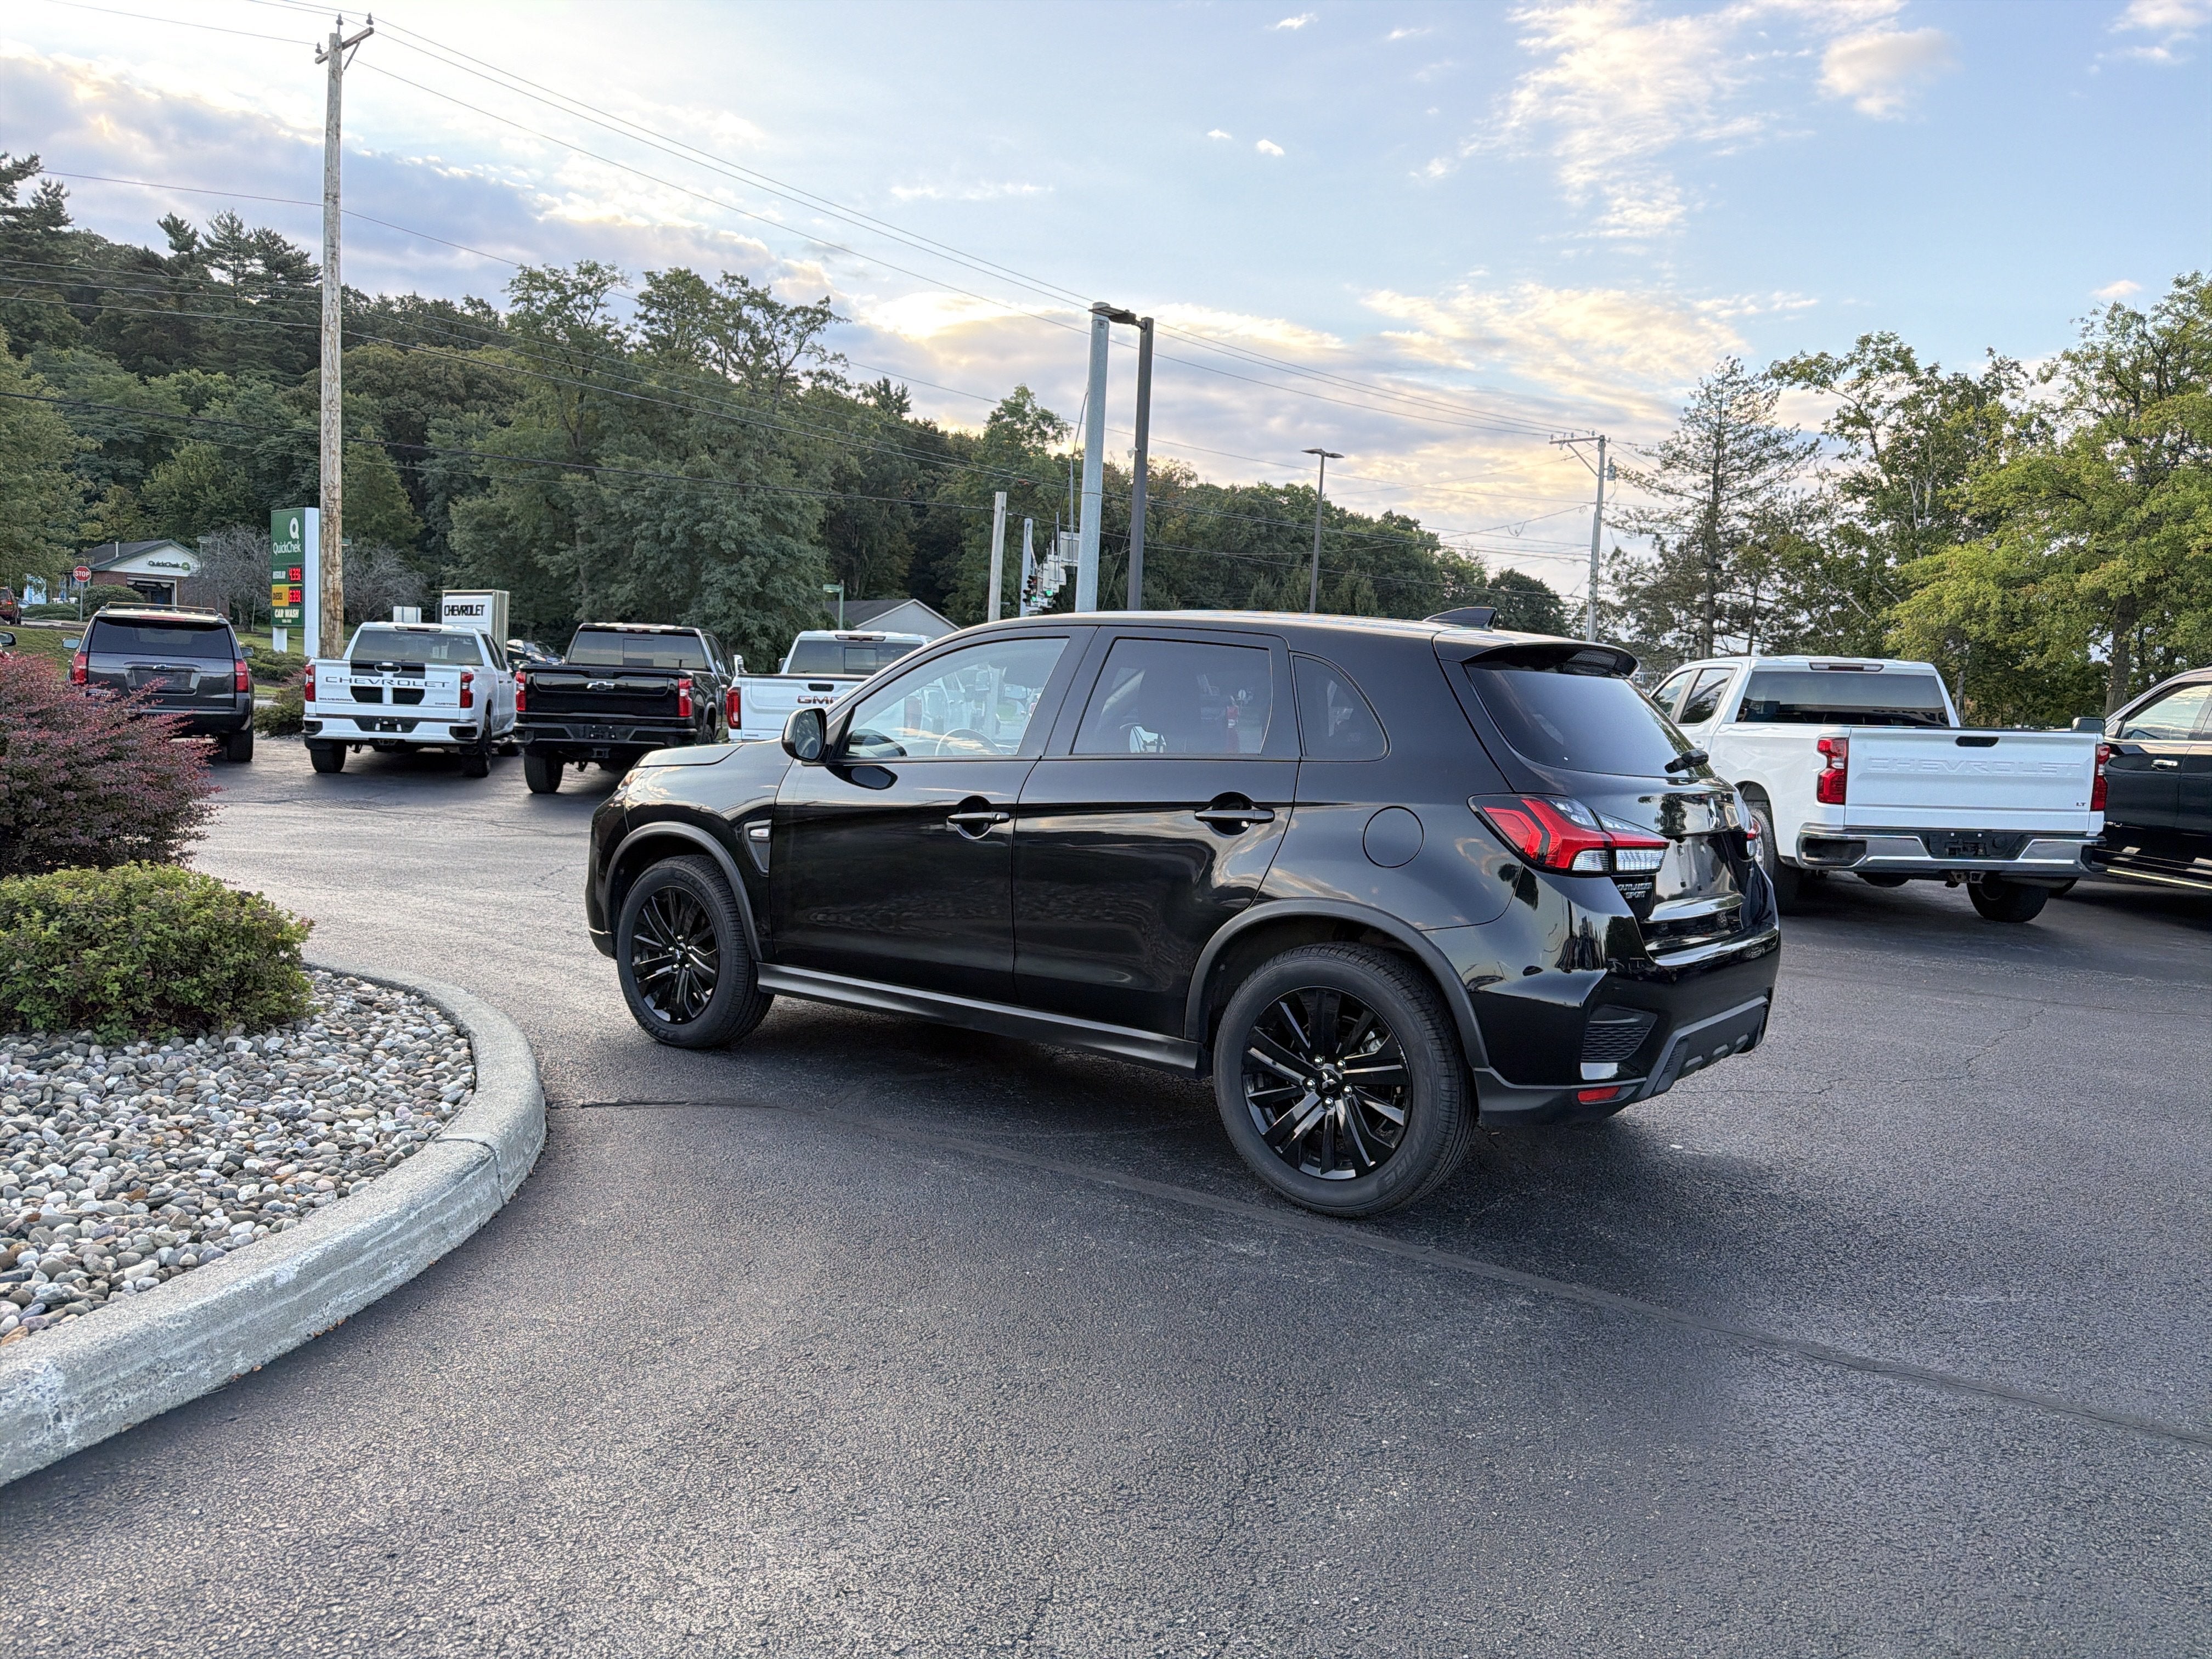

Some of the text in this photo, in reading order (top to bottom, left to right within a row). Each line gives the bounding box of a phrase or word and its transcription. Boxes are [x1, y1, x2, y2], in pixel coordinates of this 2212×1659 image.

[273, 540, 302, 556] QuickChek
[148, 560, 180, 568] QuickChek
[274, 608, 300, 619] CAR WASH
[444, 604, 486, 617] CHEVROLET
[325, 676, 450, 688] CHEVROLET
[1867, 757, 2081, 776] CHEVROLET
[1617, 882, 1652, 891] OUTLANDER
[1624, 890, 1646, 899] SPORT
